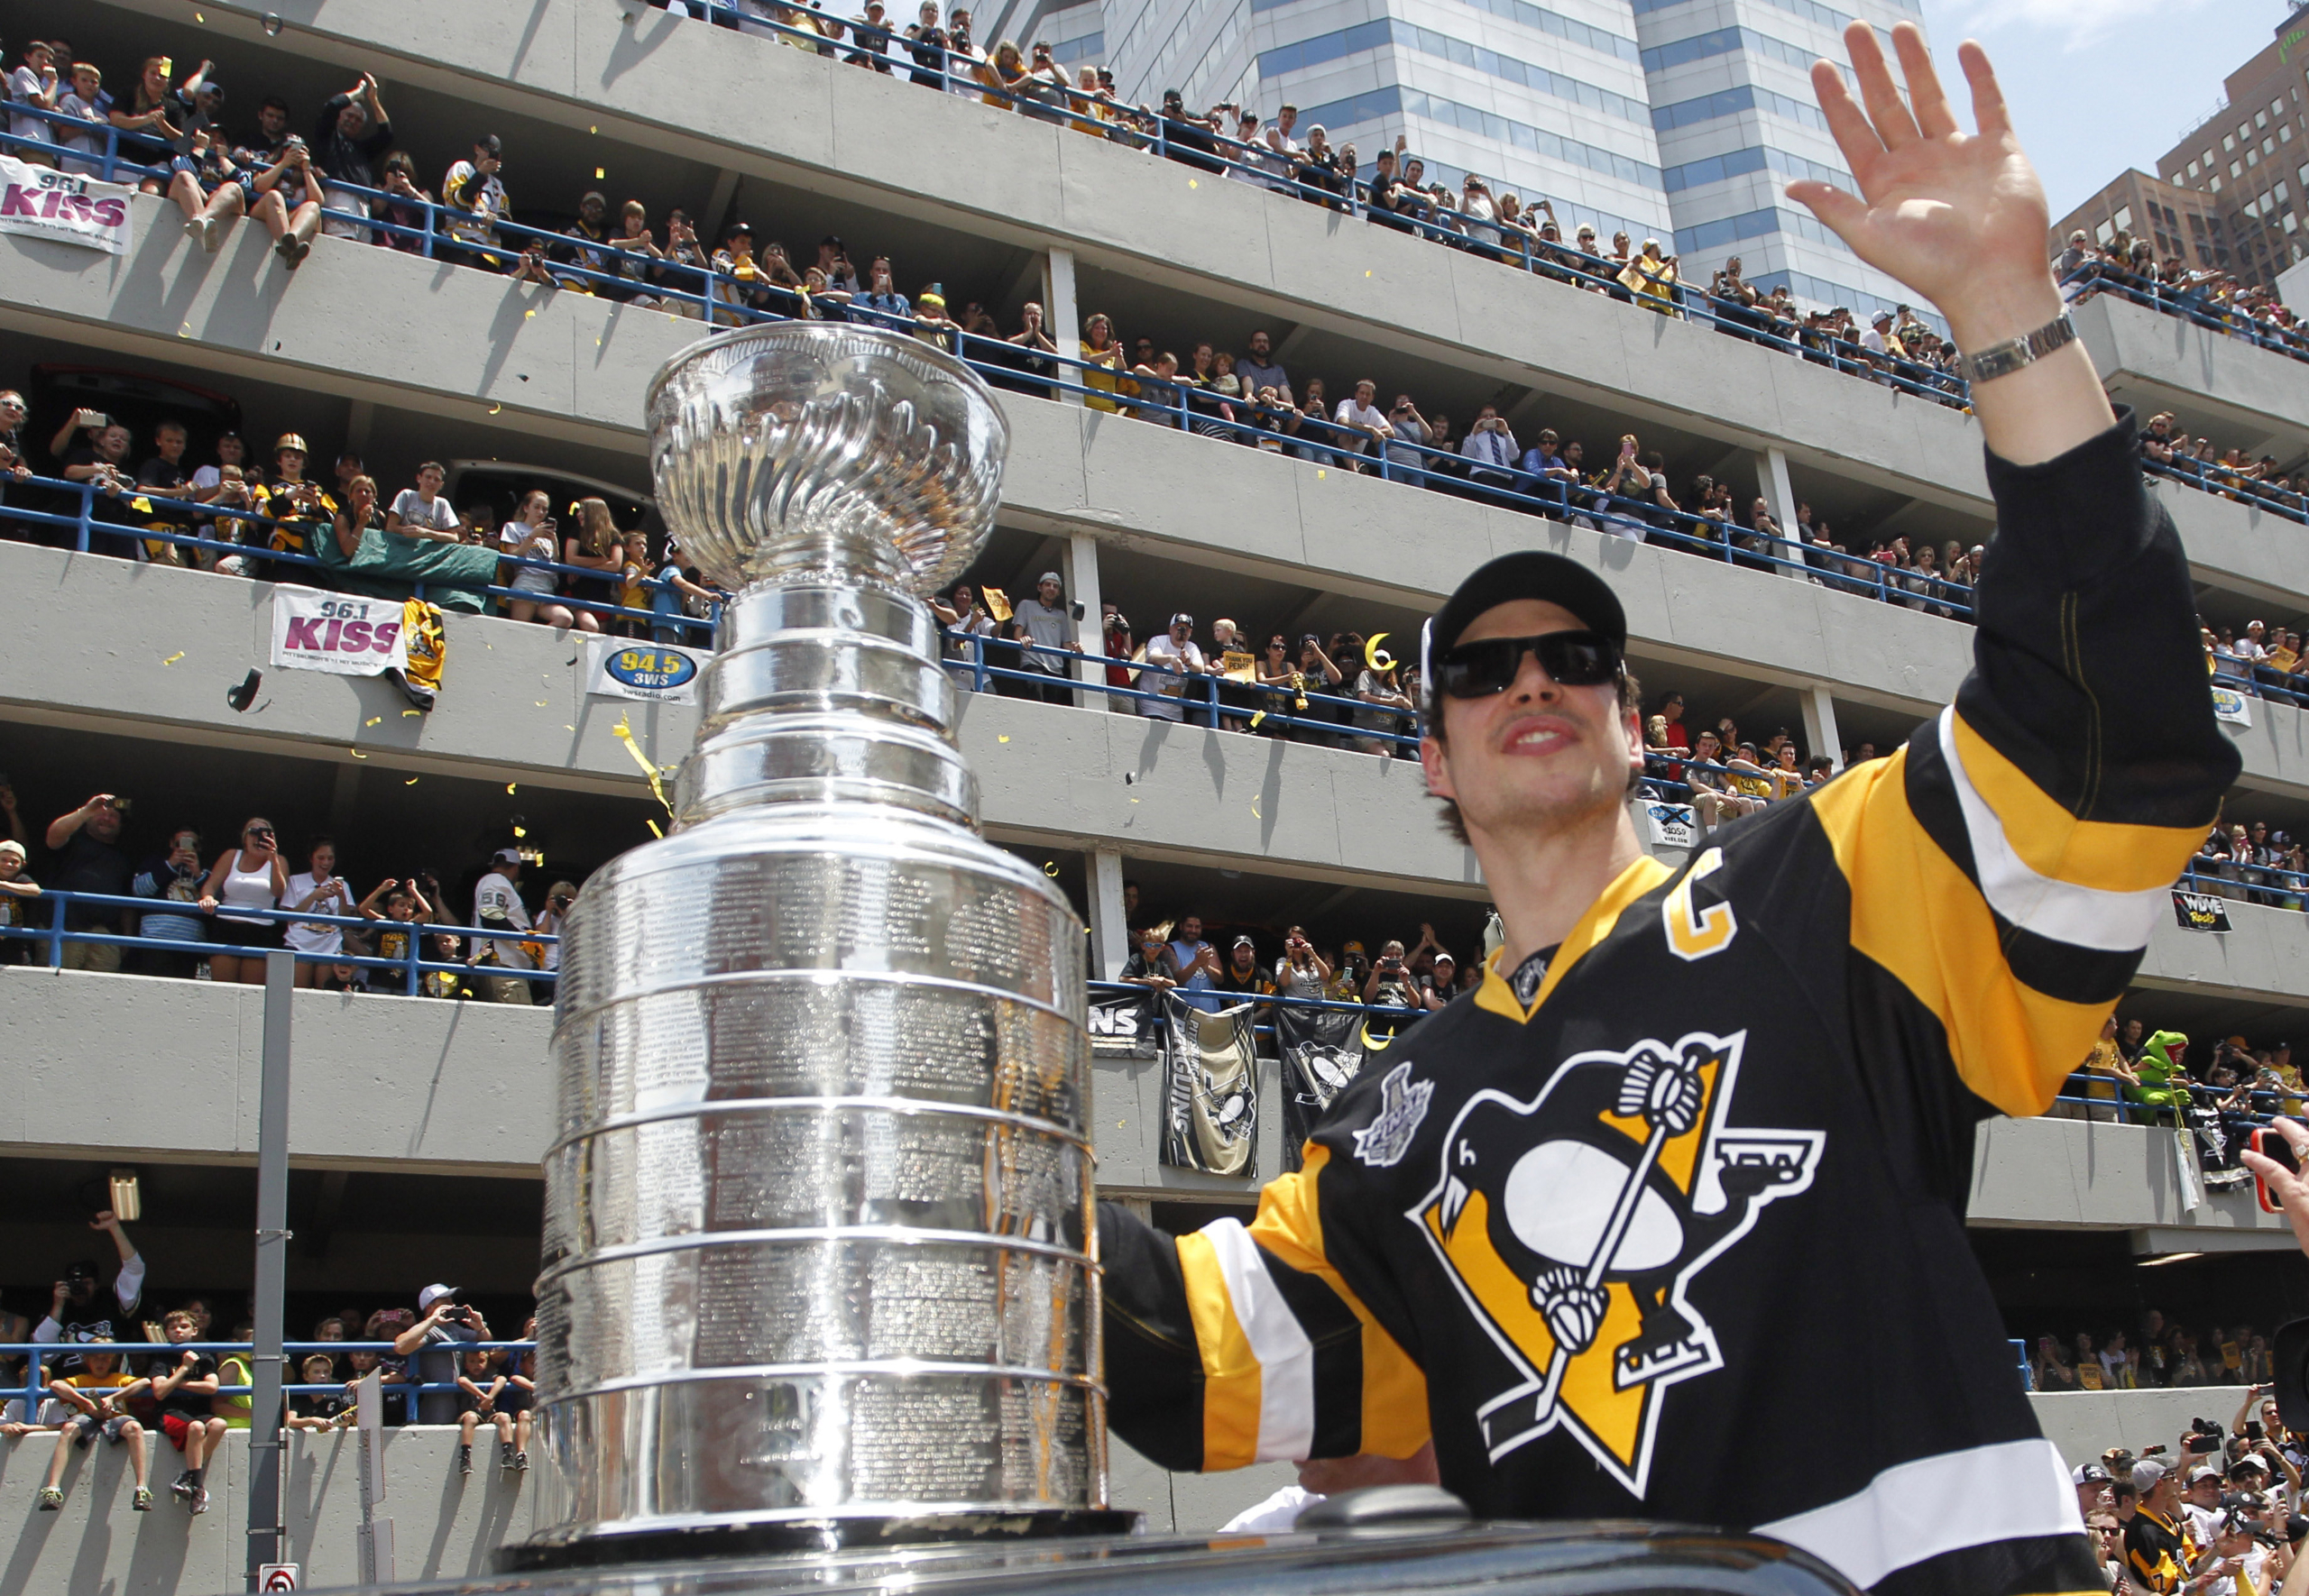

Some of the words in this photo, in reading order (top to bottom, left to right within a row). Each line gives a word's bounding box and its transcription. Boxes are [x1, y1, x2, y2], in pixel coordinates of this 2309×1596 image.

[40, 175, 87, 195] 96.1
[1, 183, 125, 227] KISS
[95, 234, 123, 246] STATION
[320, 601, 369, 619] 96.1
[285, 617, 400, 654] KISS
[621, 652, 680, 674] 94.5
[1229, 662, 1248, 670] PENS!
[634, 673, 669, 685] 3WS
[622, 688, 680, 702] 3wsradio.com
[2212, 692, 2236, 705] 94.5
[1651, 809, 1665, 818] the
[1662, 847, 1738, 961] C
[2184, 894, 2224, 914] WDVE
[2190, 911, 2216, 924] Rocks
